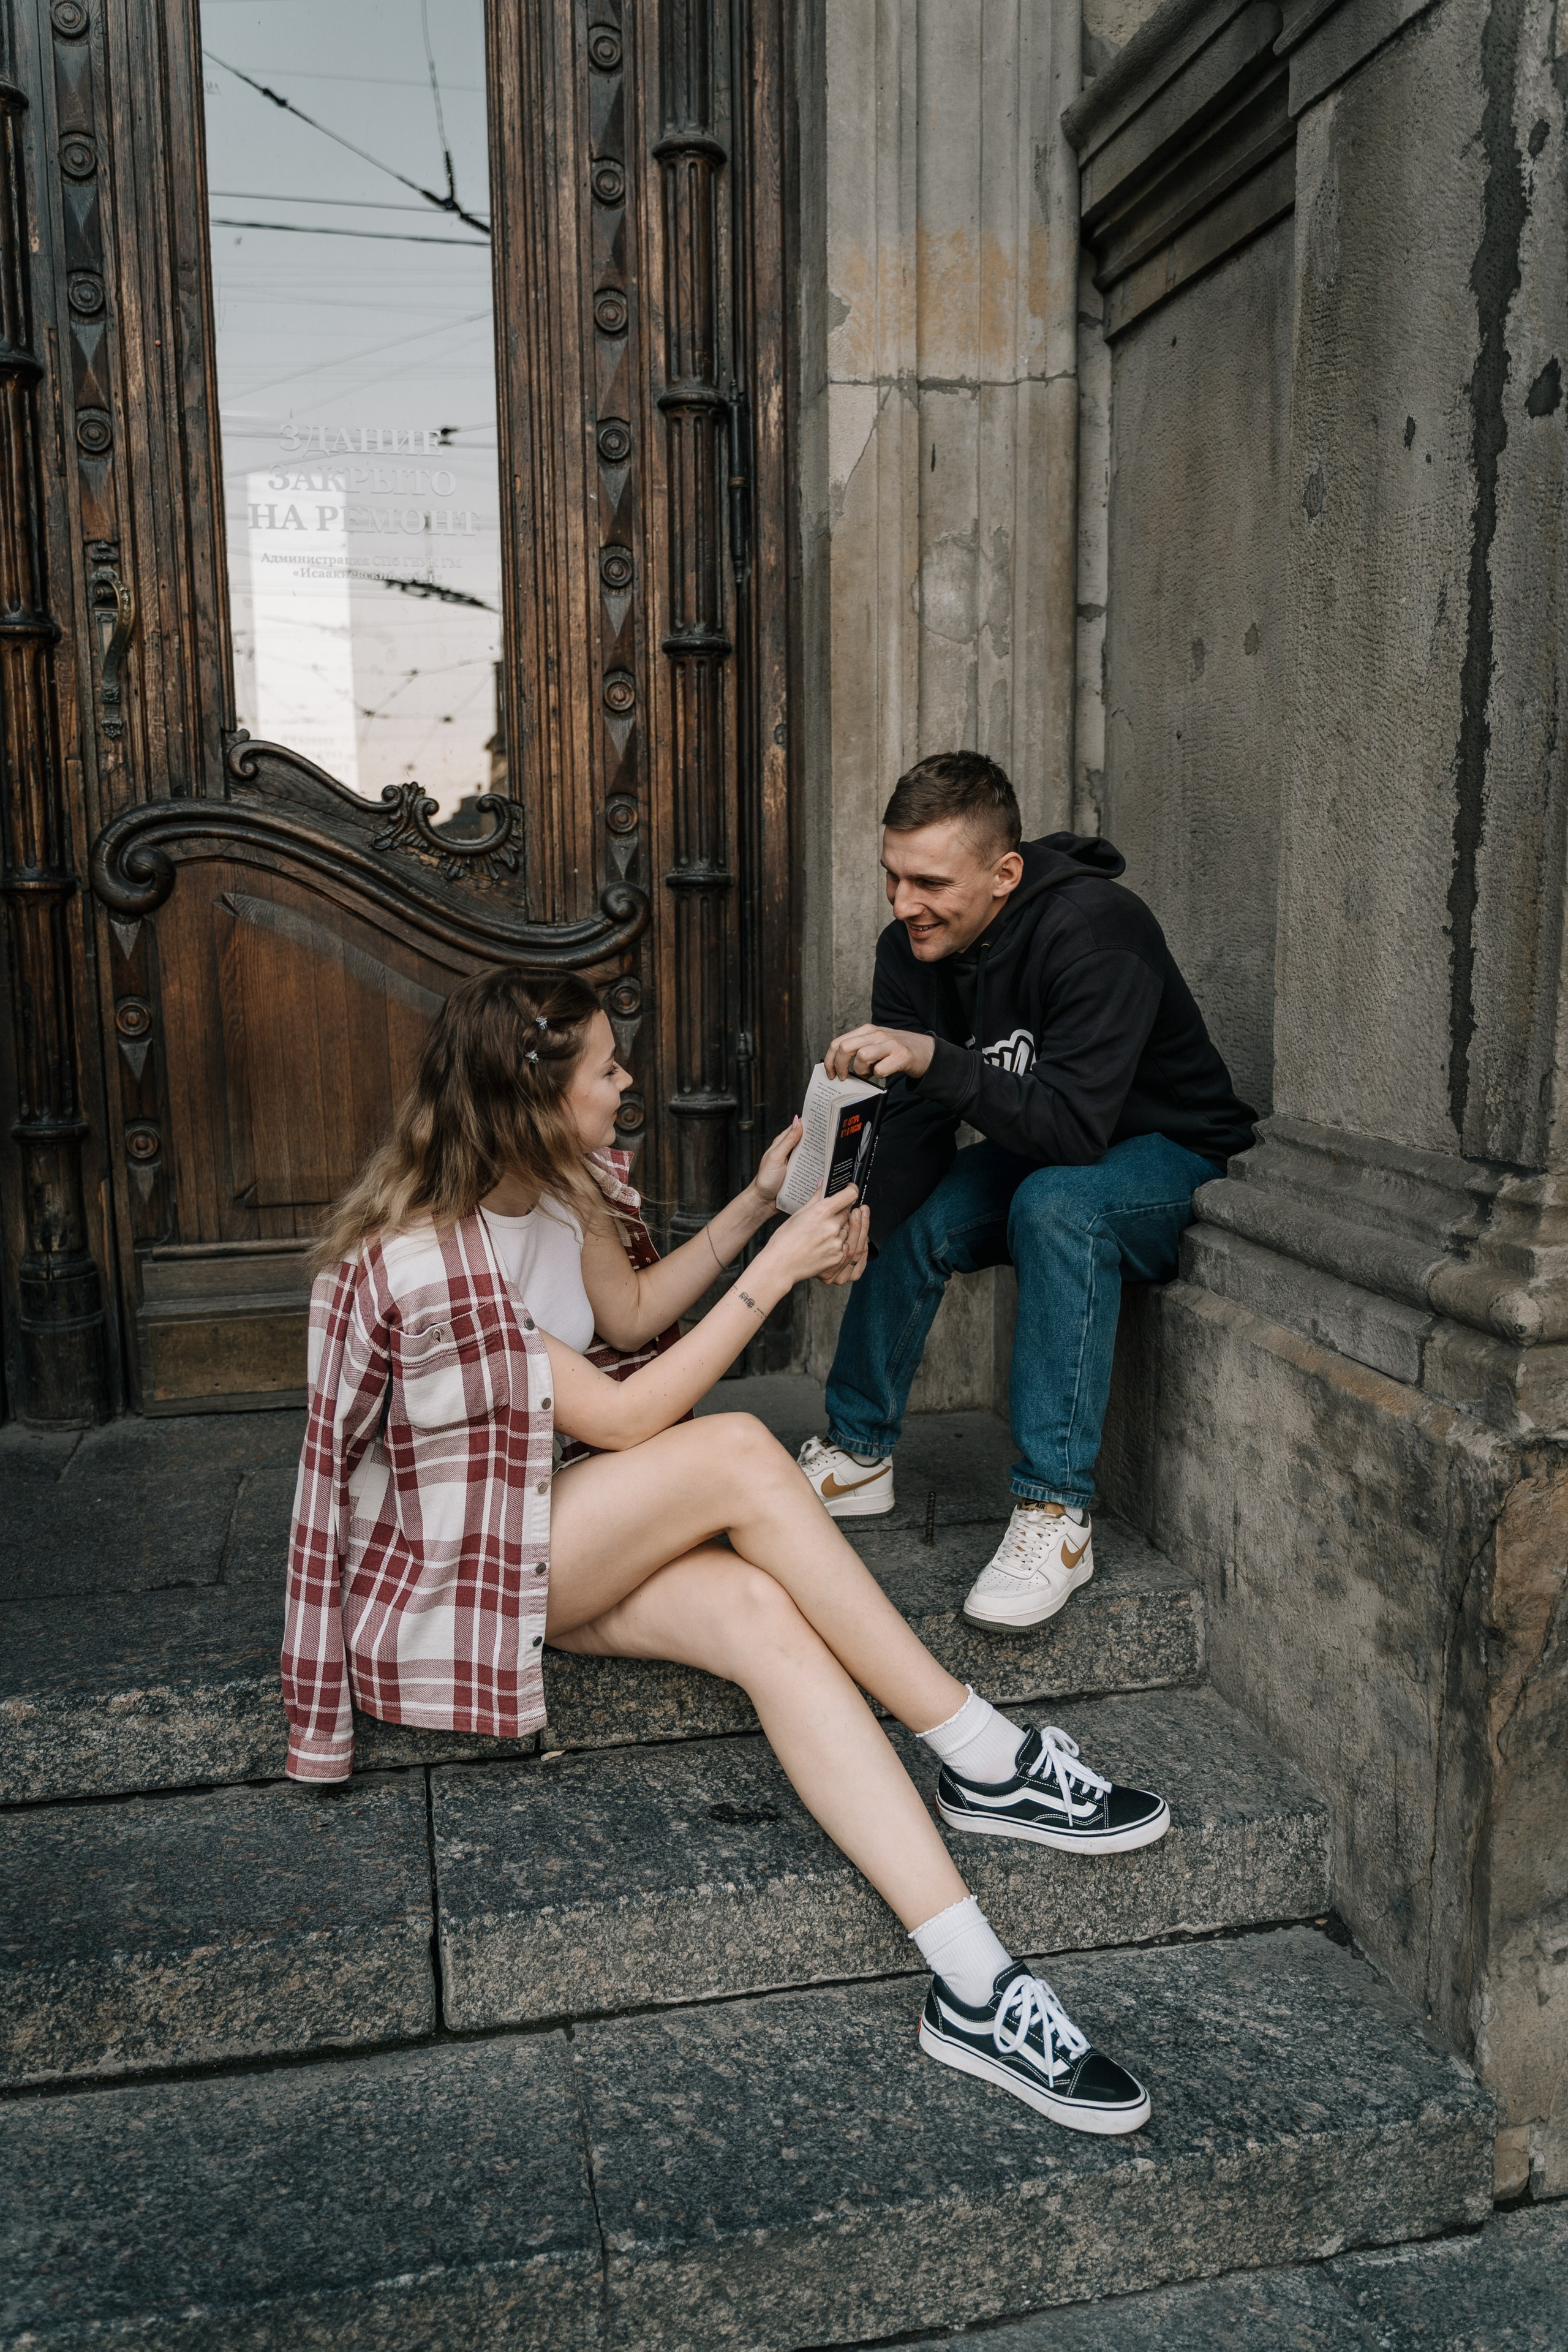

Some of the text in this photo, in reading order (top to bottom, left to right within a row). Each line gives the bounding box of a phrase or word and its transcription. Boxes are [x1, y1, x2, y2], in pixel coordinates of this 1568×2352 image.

[279, 424, 443, 458] ЗДАНИЕ
[268, 464, 457, 497] ЗАКРЫТО
[247, 503, 480, 537] НА РЕМОНТ
[260, 552, 369, 567] Администрация
